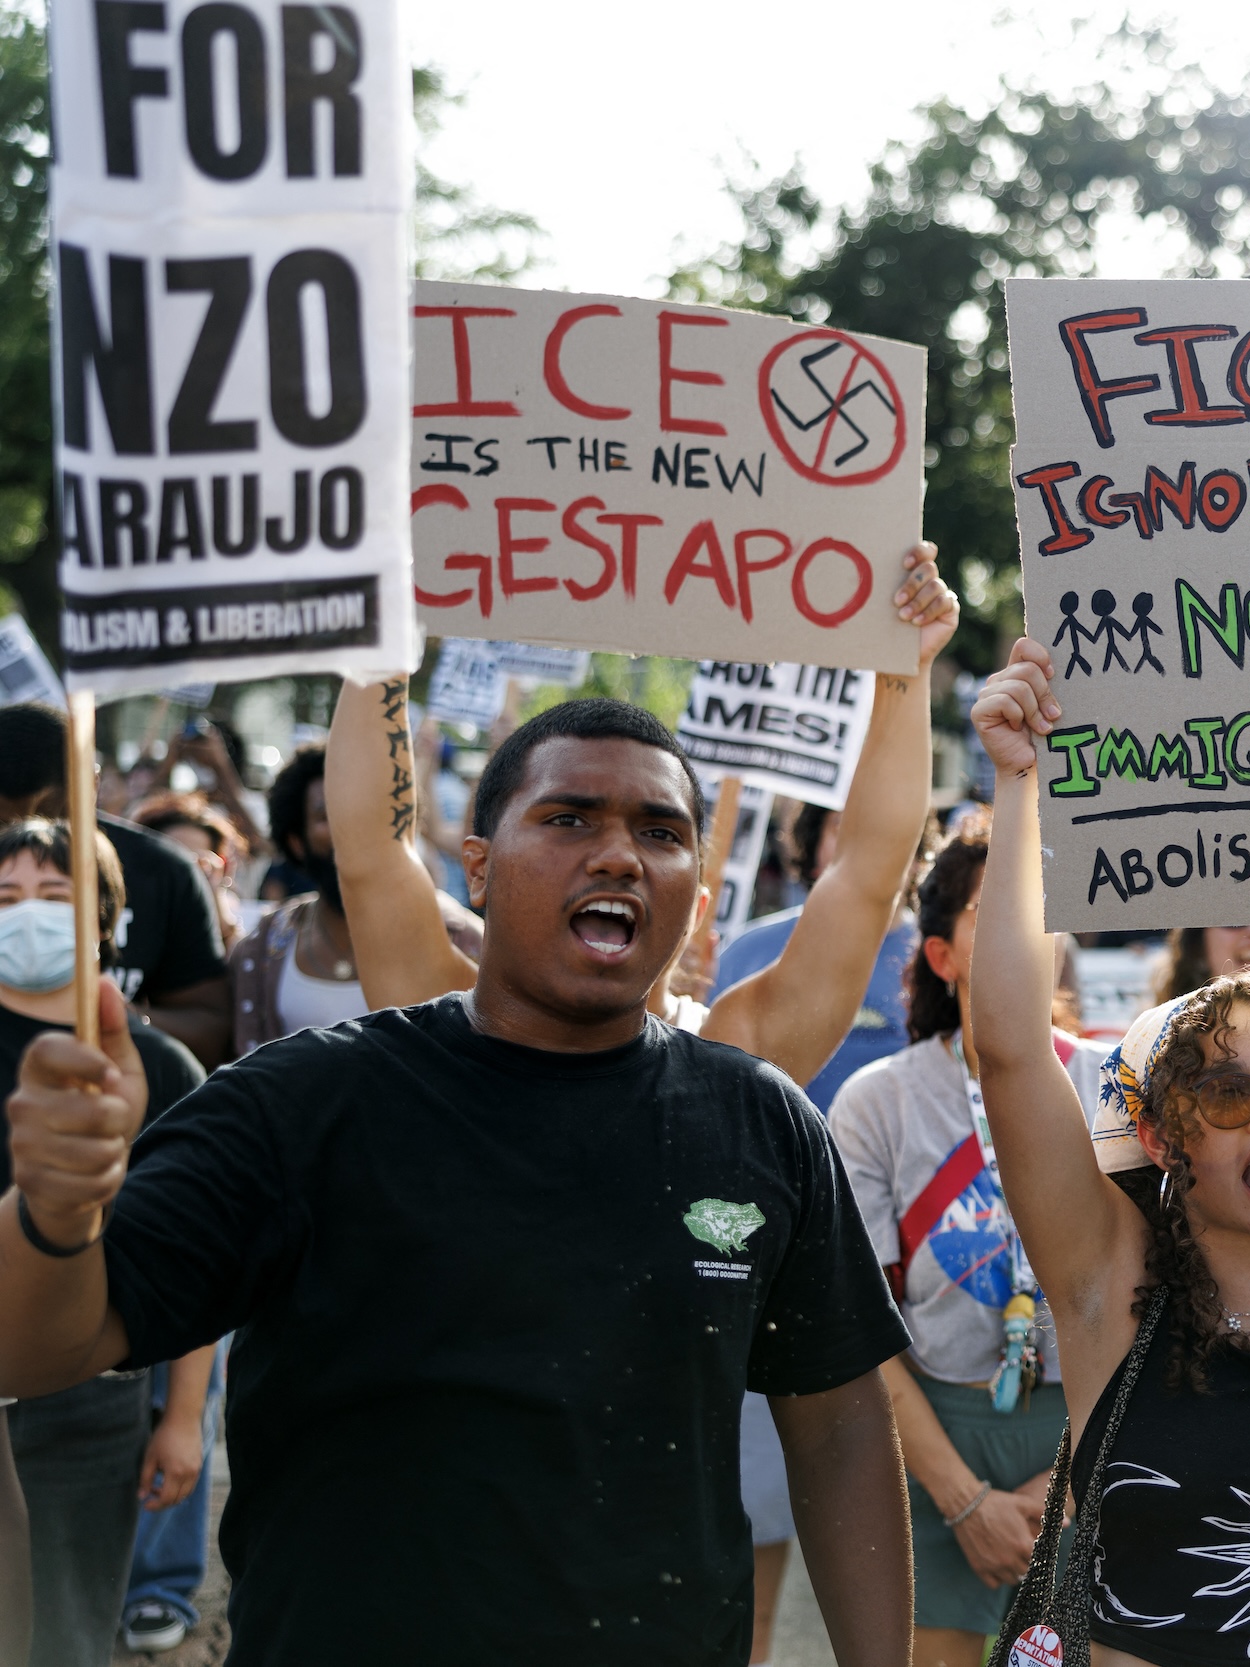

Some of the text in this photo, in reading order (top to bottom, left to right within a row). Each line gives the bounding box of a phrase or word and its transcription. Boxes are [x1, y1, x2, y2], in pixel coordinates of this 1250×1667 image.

[93, 3, 363, 183] FOR
[412, 304, 732, 437] ICE
[420, 433, 767, 498] IS THE NEW
[61, 466, 364, 569] ARAUJO
[411, 483, 874, 629] GESTAPO
[165, 606, 192, 646] &
[197, 592, 366, 643] LIBERATION
[694, 1260, 731, 1270] ECOLOGICAL
[1029, 1625, 1060, 1652] NO
